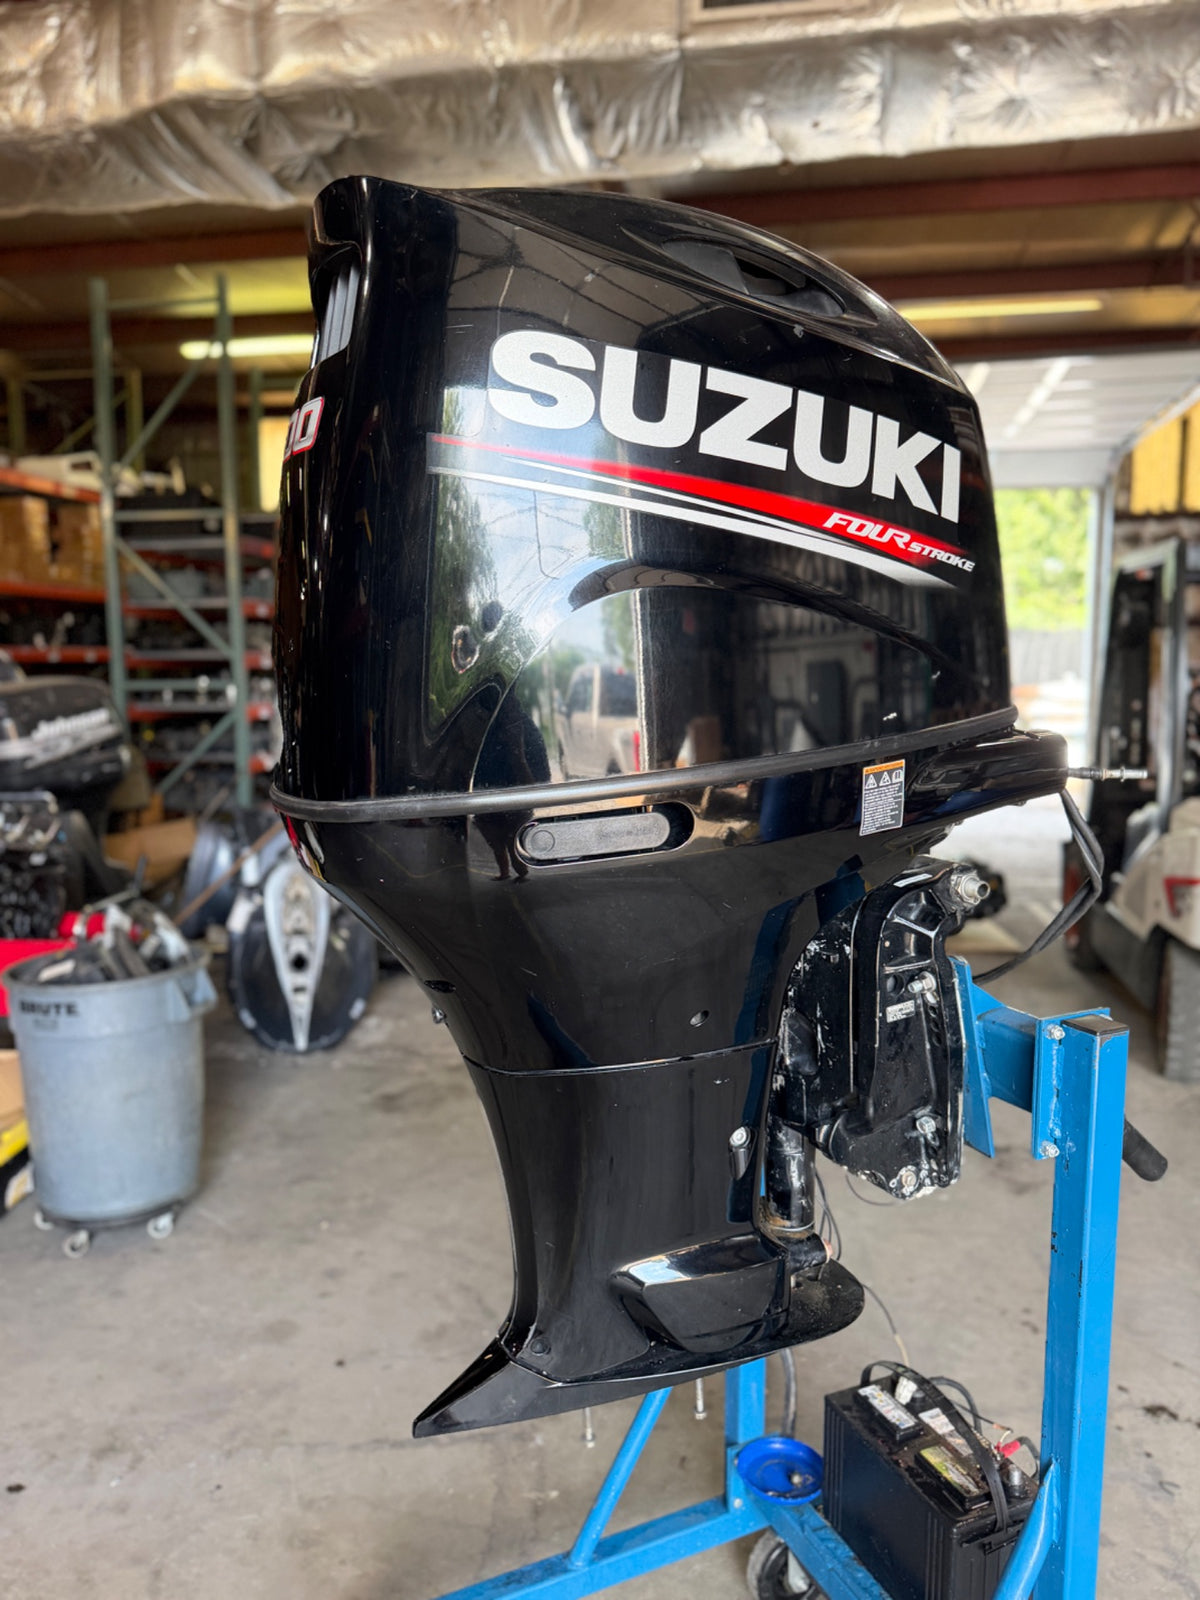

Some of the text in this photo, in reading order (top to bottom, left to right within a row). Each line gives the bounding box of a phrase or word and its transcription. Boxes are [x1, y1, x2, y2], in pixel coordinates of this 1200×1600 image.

[488, 330, 961, 523] SUZUKI
[823, 512, 976, 573] FOUR STROKE
